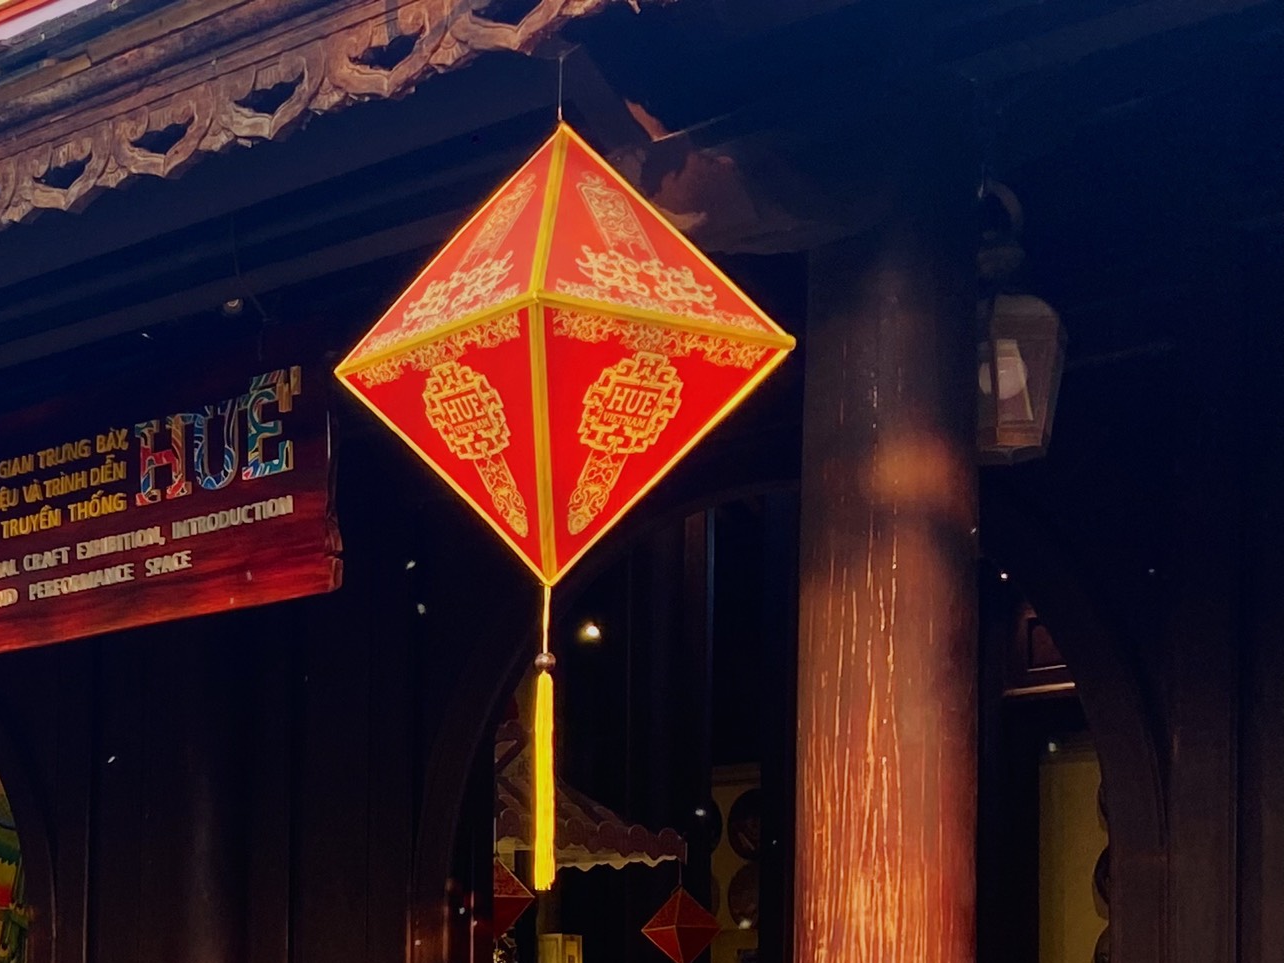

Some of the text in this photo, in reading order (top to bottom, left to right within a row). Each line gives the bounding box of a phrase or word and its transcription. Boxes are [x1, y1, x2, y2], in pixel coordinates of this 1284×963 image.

[443, 394, 484, 424] HUE
[454, 418, 490, 435] VIETNAM
[602, 411, 648, 428] VIETNAM
[608, 387, 657, 416] HUE
[134, 365, 303, 507] HUẾ
[22, 478, 44, 504] VÀ
[43, 471, 89, 499] TRÌNH
[89, 453, 128, 487] DIỄN
[0, 504, 62, 540] TRUYỀN
[67, 489, 128, 523] THỐNG
[22, 546, 71, 572] CRAFT
[76, 525, 166, 561] EXHIBITION,
[171, 494, 294, 540] INTRODUCTION
[28, 563, 135, 601] PERFORMANCE
[144, 550, 193, 578] SPACE
